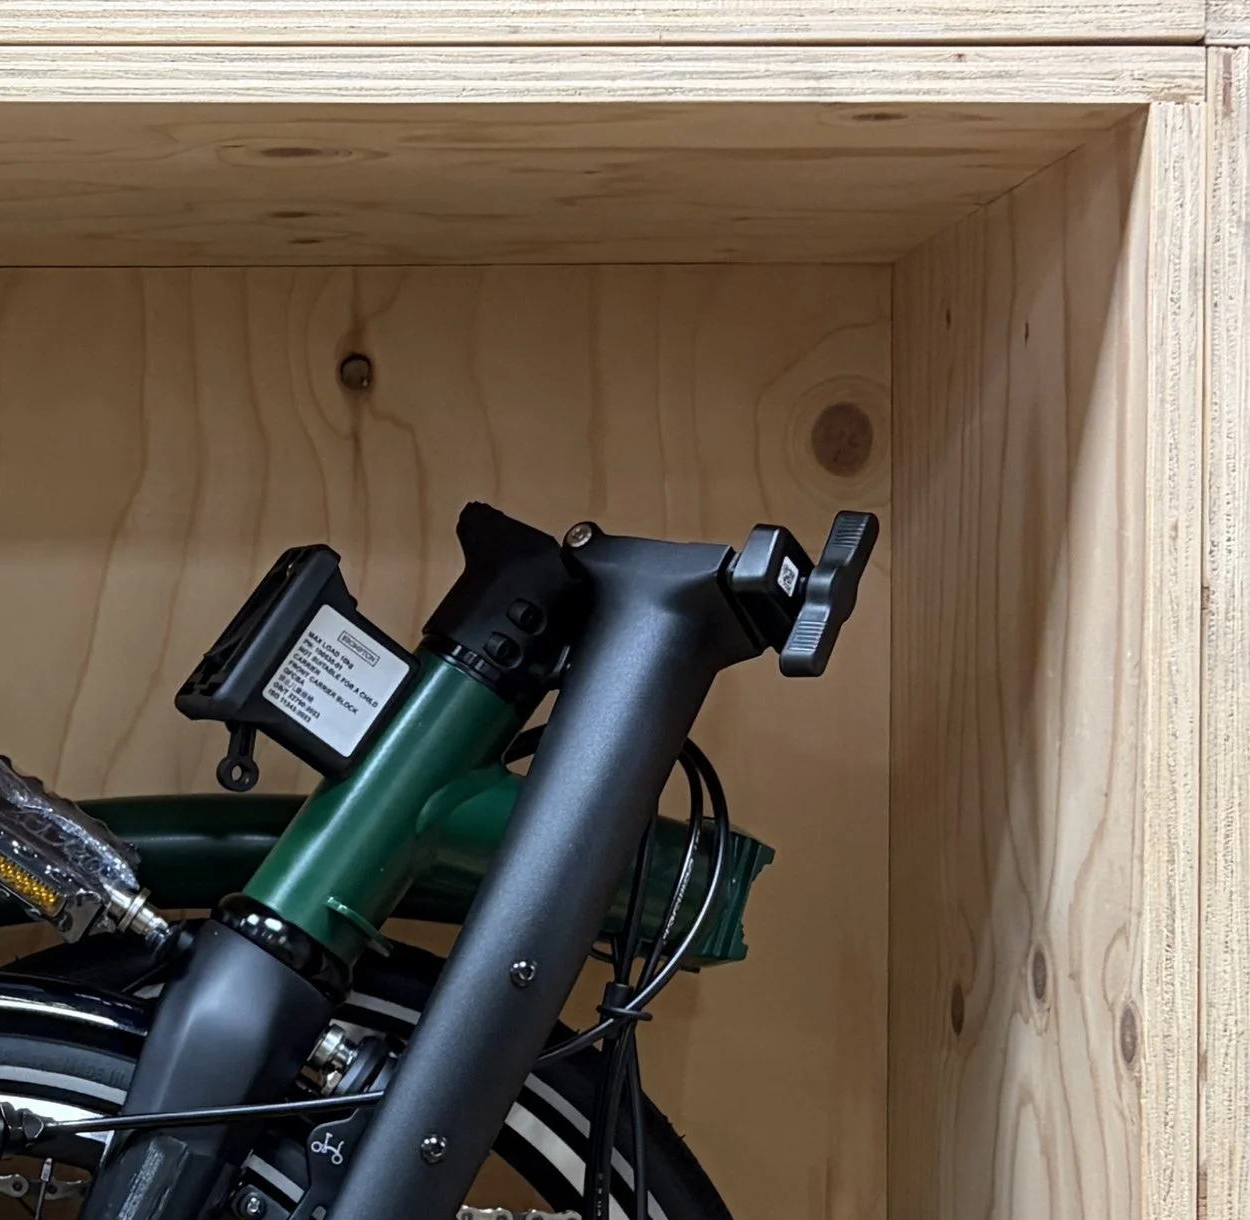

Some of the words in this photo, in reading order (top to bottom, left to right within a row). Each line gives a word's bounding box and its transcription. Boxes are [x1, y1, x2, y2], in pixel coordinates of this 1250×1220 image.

[292, 653, 321, 675] CARRIER
[307, 631, 323, 644] MAX
[321, 642, 340, 657] LOAD
[338, 655, 354, 669] 10kg
[340, 635, 376, 662] BROMPTON
[287, 660, 309, 678] FRONT
[308, 675, 337, 698] CARRIER
[335, 695, 358, 714] BLOCK
[297, 645, 311, 658] NOT
[310, 655, 341, 680] SUITABLE
[339, 677, 354, 690] FOR
[358, 691, 378, 707] CHILD
[267, 688, 280, 699] ISO
